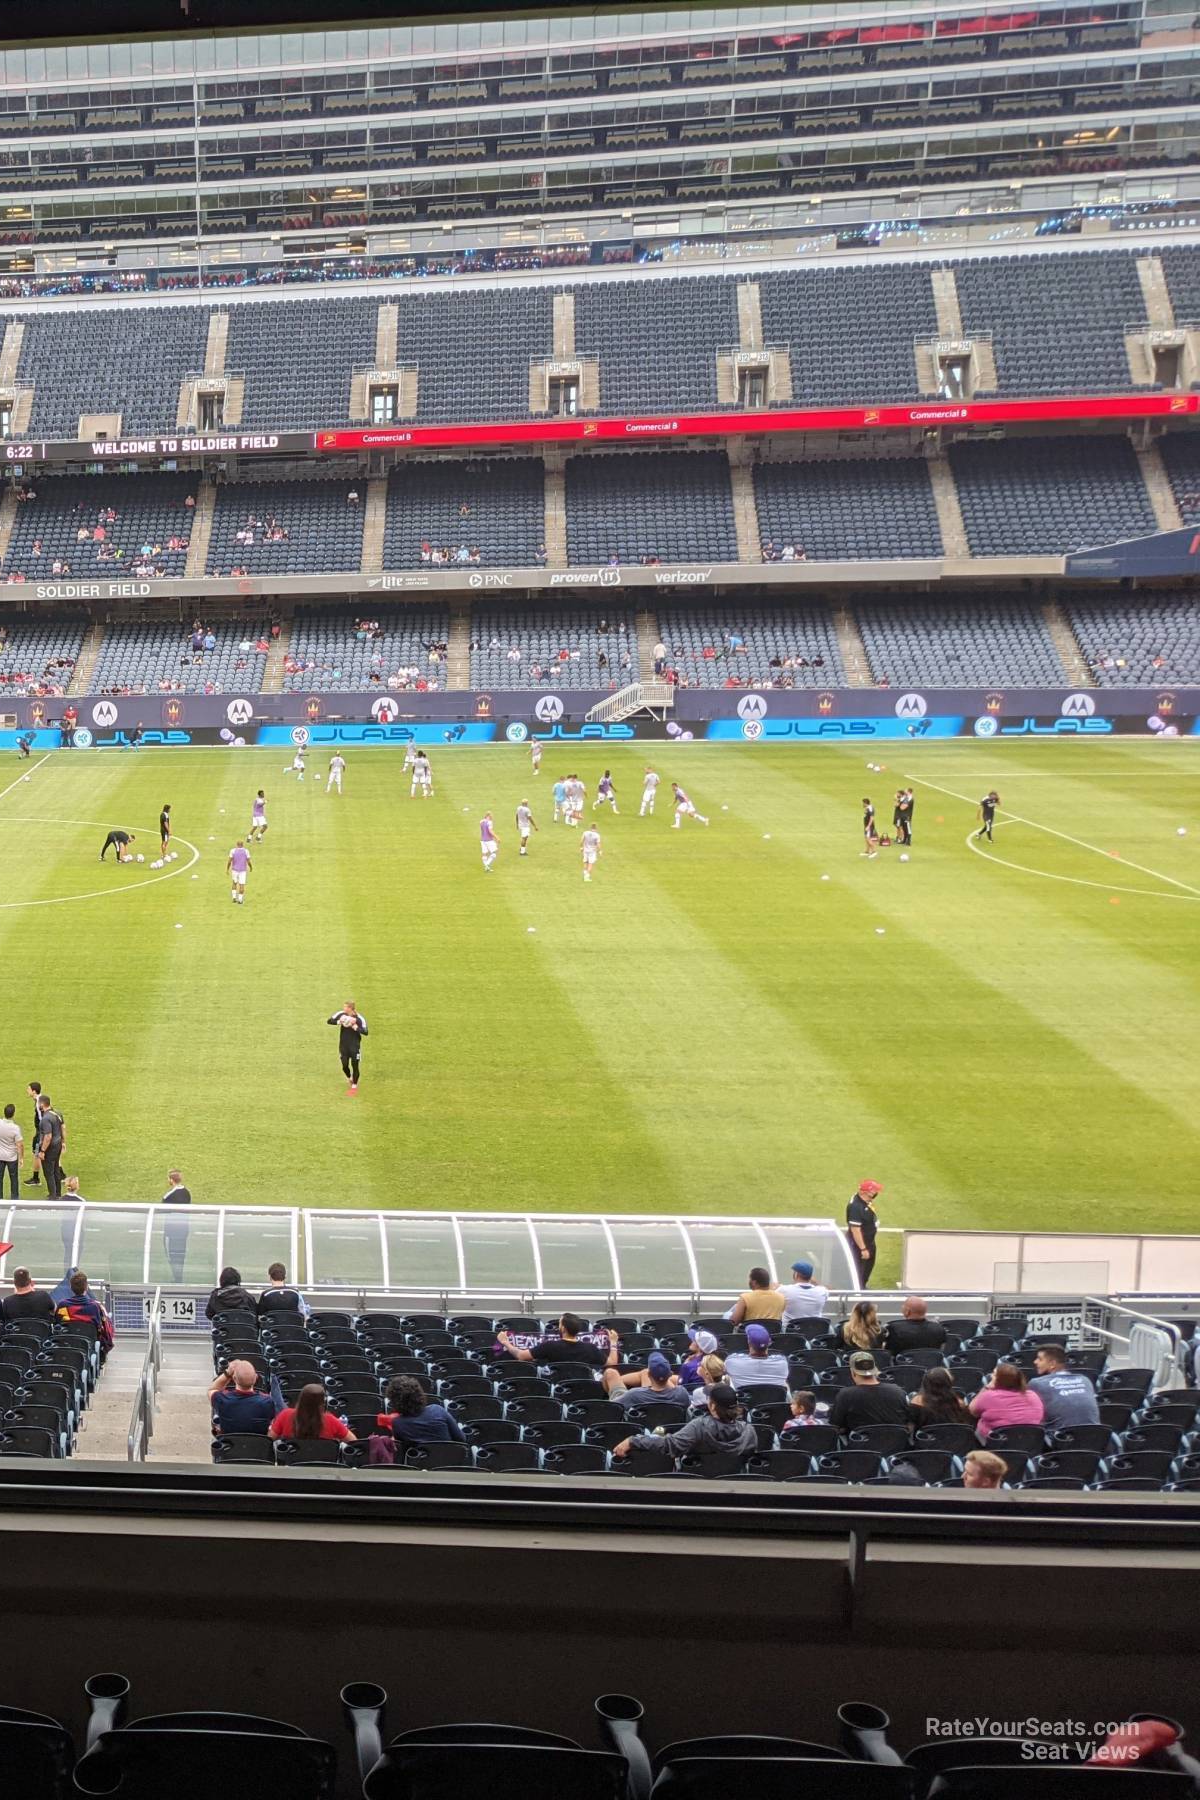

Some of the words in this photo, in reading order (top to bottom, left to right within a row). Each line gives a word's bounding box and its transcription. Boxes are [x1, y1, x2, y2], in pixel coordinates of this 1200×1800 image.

[910, 410, 960, 419] Commercial
[625, 422, 671, 432] Commercial
[92, 440, 156, 455] WELCOME
[160, 439, 177, 452] TO
[181, 437, 237, 451] SOLDIER
[241, 436, 279, 449] FIELD
[362, 434, 405, 443] Commercial
[6, 446, 33, 459] 6:22
[381, 576, 403, 590] Lite
[484, 574, 513, 586] PNC
[550, 571, 598, 585] proven
[655, 569, 706, 584] verizon
[36, 585, 100, 599] SOLDIER
[108, 583, 151, 597] FIELD
[534, 723, 636, 740] JLAB
[766, 721, 876, 736] JLAB
[1001, 718, 1113, 734] JLAB
[145, 1299, 167, 1314] 16
[172, 1300, 194, 1315] 134
[1029, 1317, 1052, 1332] 134
[1059, 1316, 1081, 1331] 133
